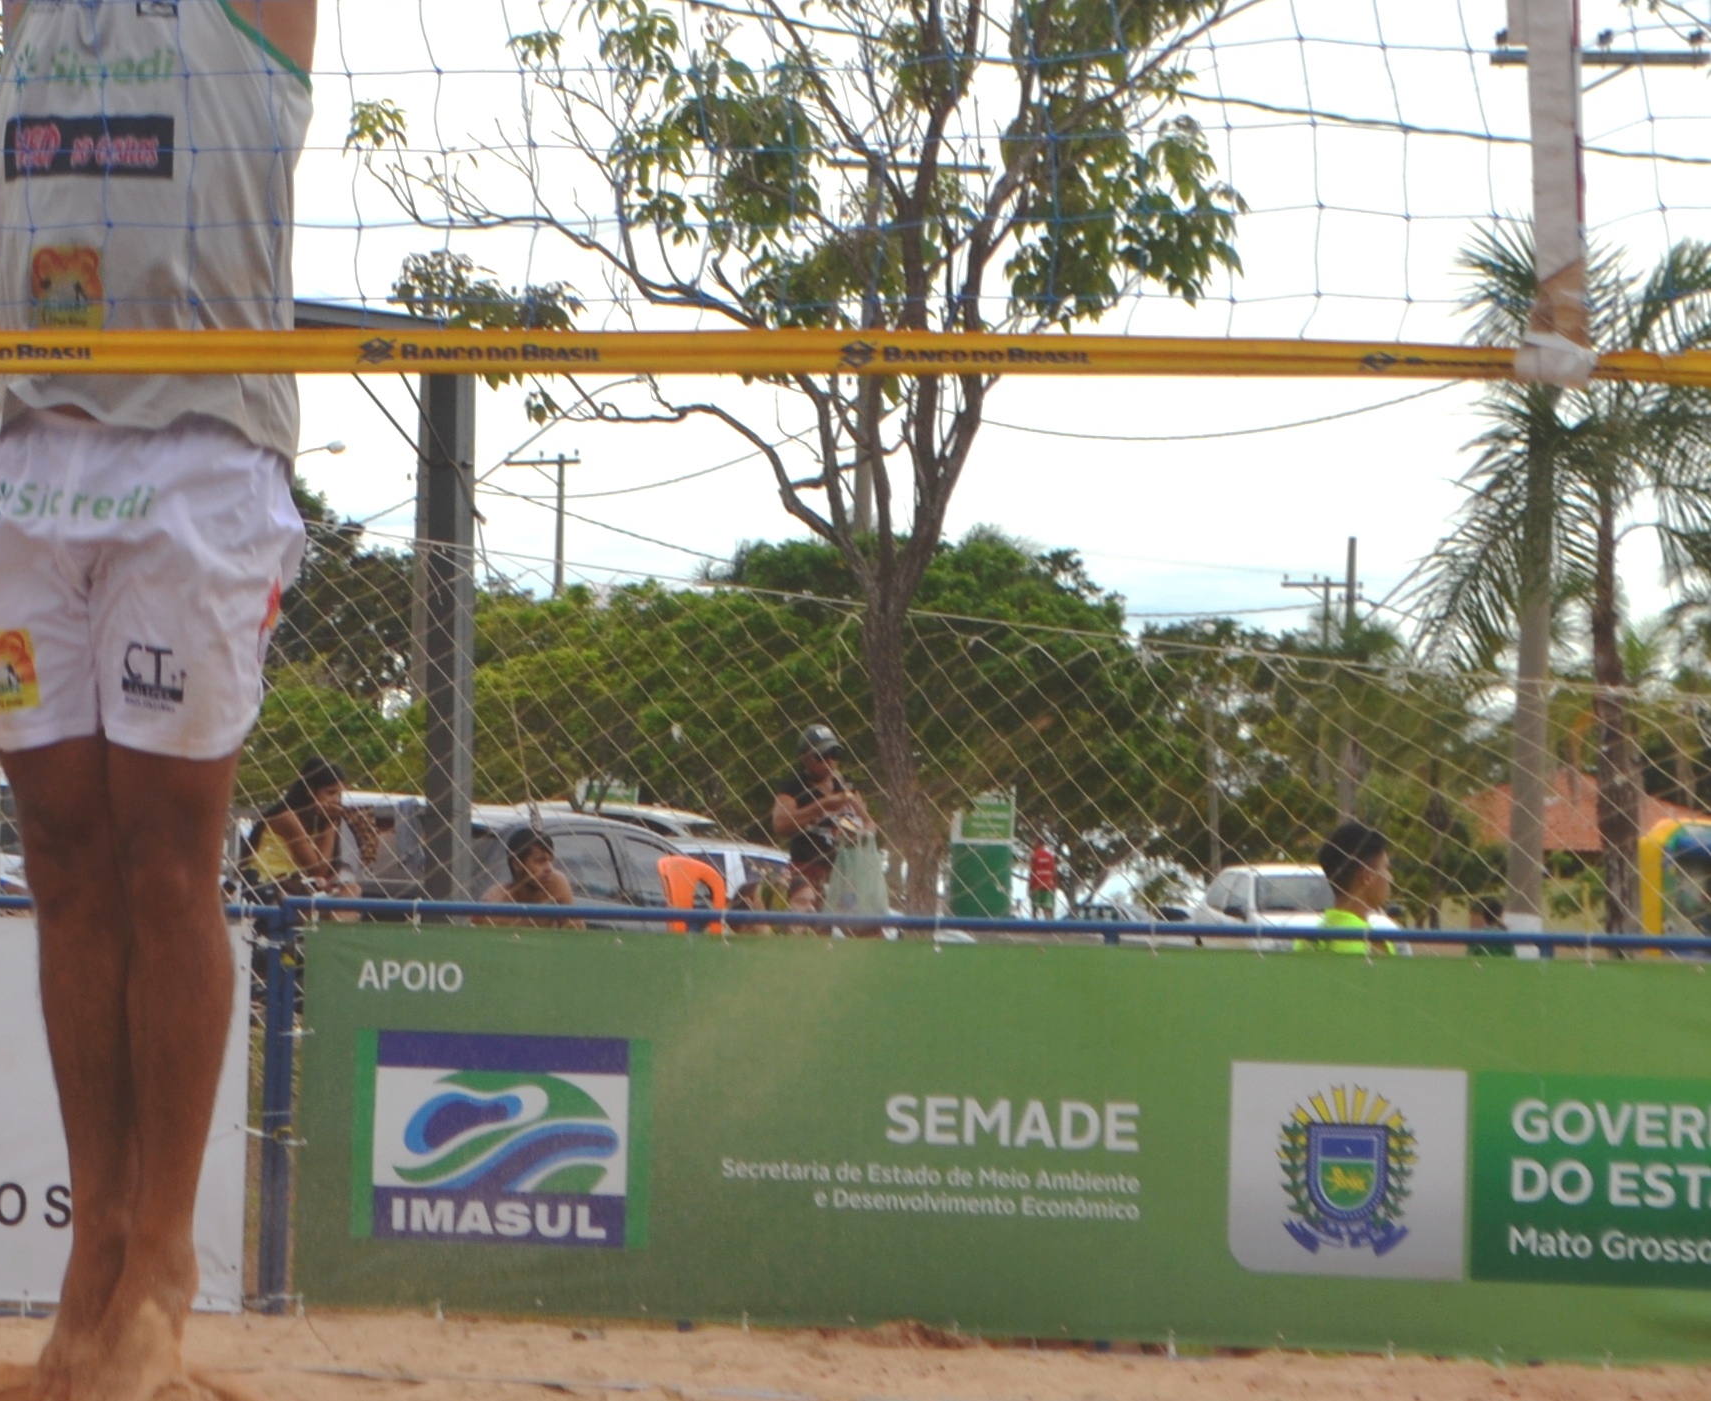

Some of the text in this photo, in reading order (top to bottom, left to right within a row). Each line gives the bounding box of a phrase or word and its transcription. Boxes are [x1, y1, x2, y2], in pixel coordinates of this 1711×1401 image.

[357, 959, 464, 993] APOIO
[885, 1094, 1141, 1153] SEMADE
[1511, 1098, 1711, 1150] GOVER
[722, 1157, 1142, 1195] Secretaria de Estado de Meio Ambiente
[1511, 1157, 1711, 1211] DO EST
[391, 1197, 608, 1241] IMASUL
[814, 1188, 1142, 1222] e Desenvolvimento Econômico
[1508, 1224, 1711, 1265] Mato Grosso
